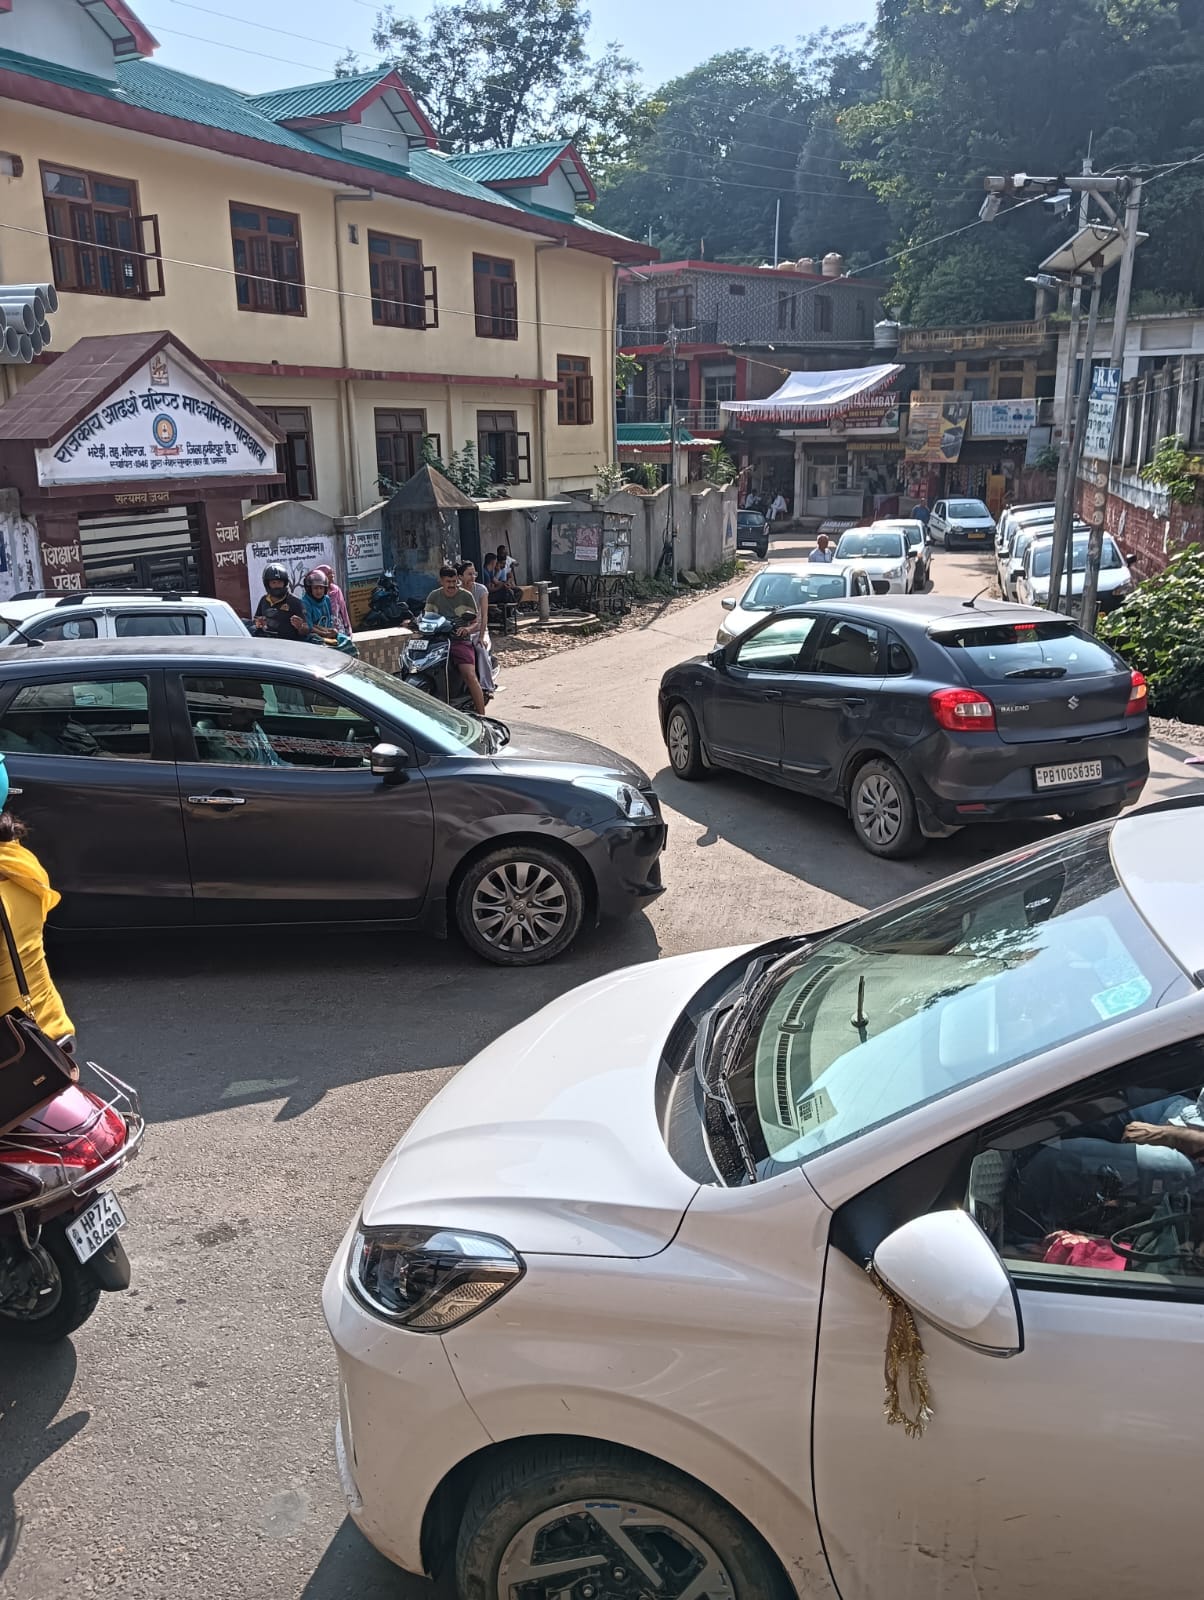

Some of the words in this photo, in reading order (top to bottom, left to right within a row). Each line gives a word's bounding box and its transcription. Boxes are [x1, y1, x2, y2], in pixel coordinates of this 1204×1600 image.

[214, 549, 245, 568] प्रस्थान
[1042, 763, 1101, 784] PB10GS6356
[85, 1211, 122, 1252] A8490
